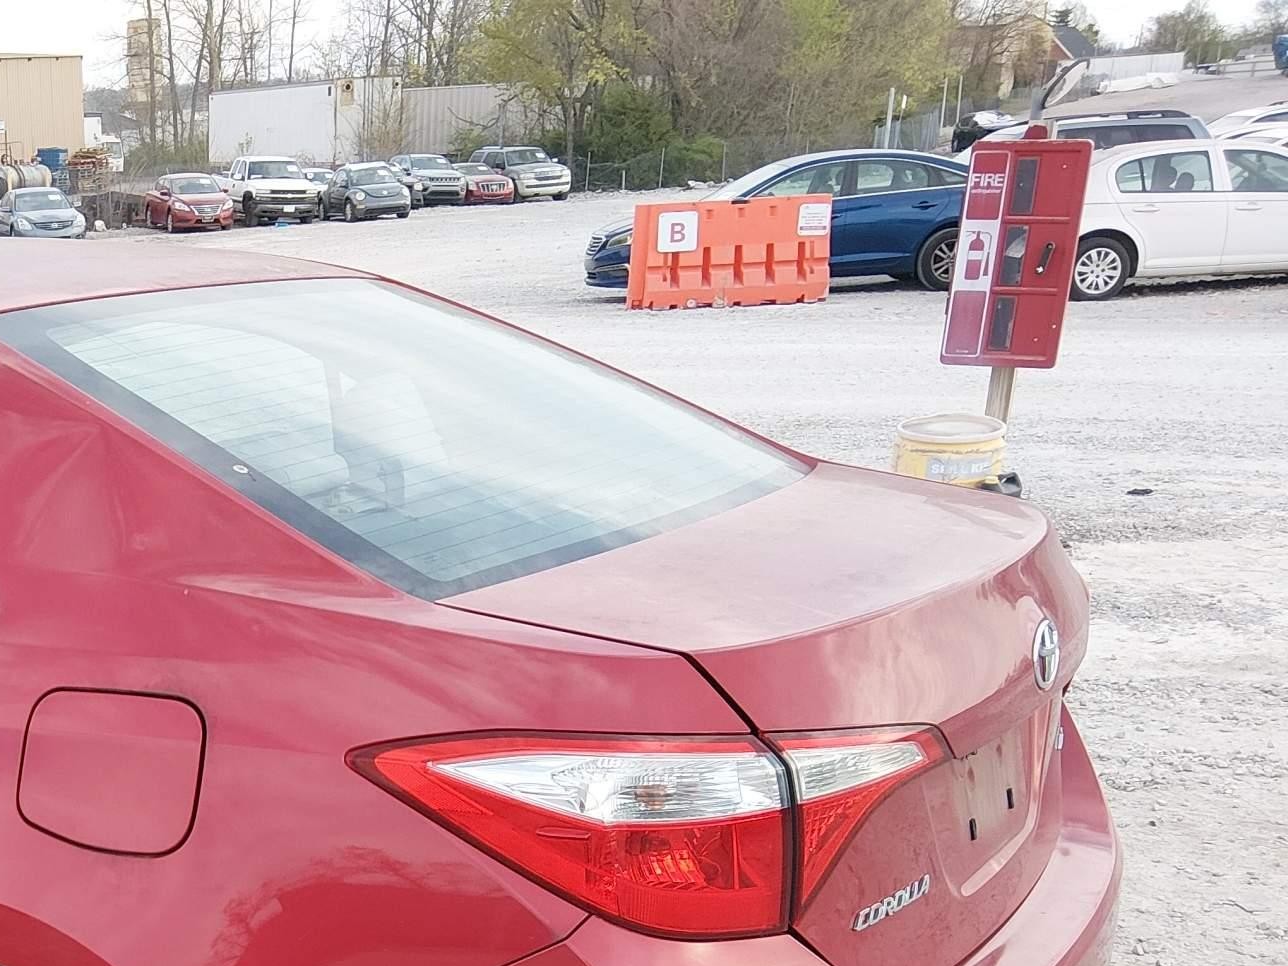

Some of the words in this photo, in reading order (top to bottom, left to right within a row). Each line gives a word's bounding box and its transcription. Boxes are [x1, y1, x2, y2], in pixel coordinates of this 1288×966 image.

[970, 173, 1005, 187] FIRE
[669, 222, 686, 243] B
[851, 873, 931, 931] COROLLA
